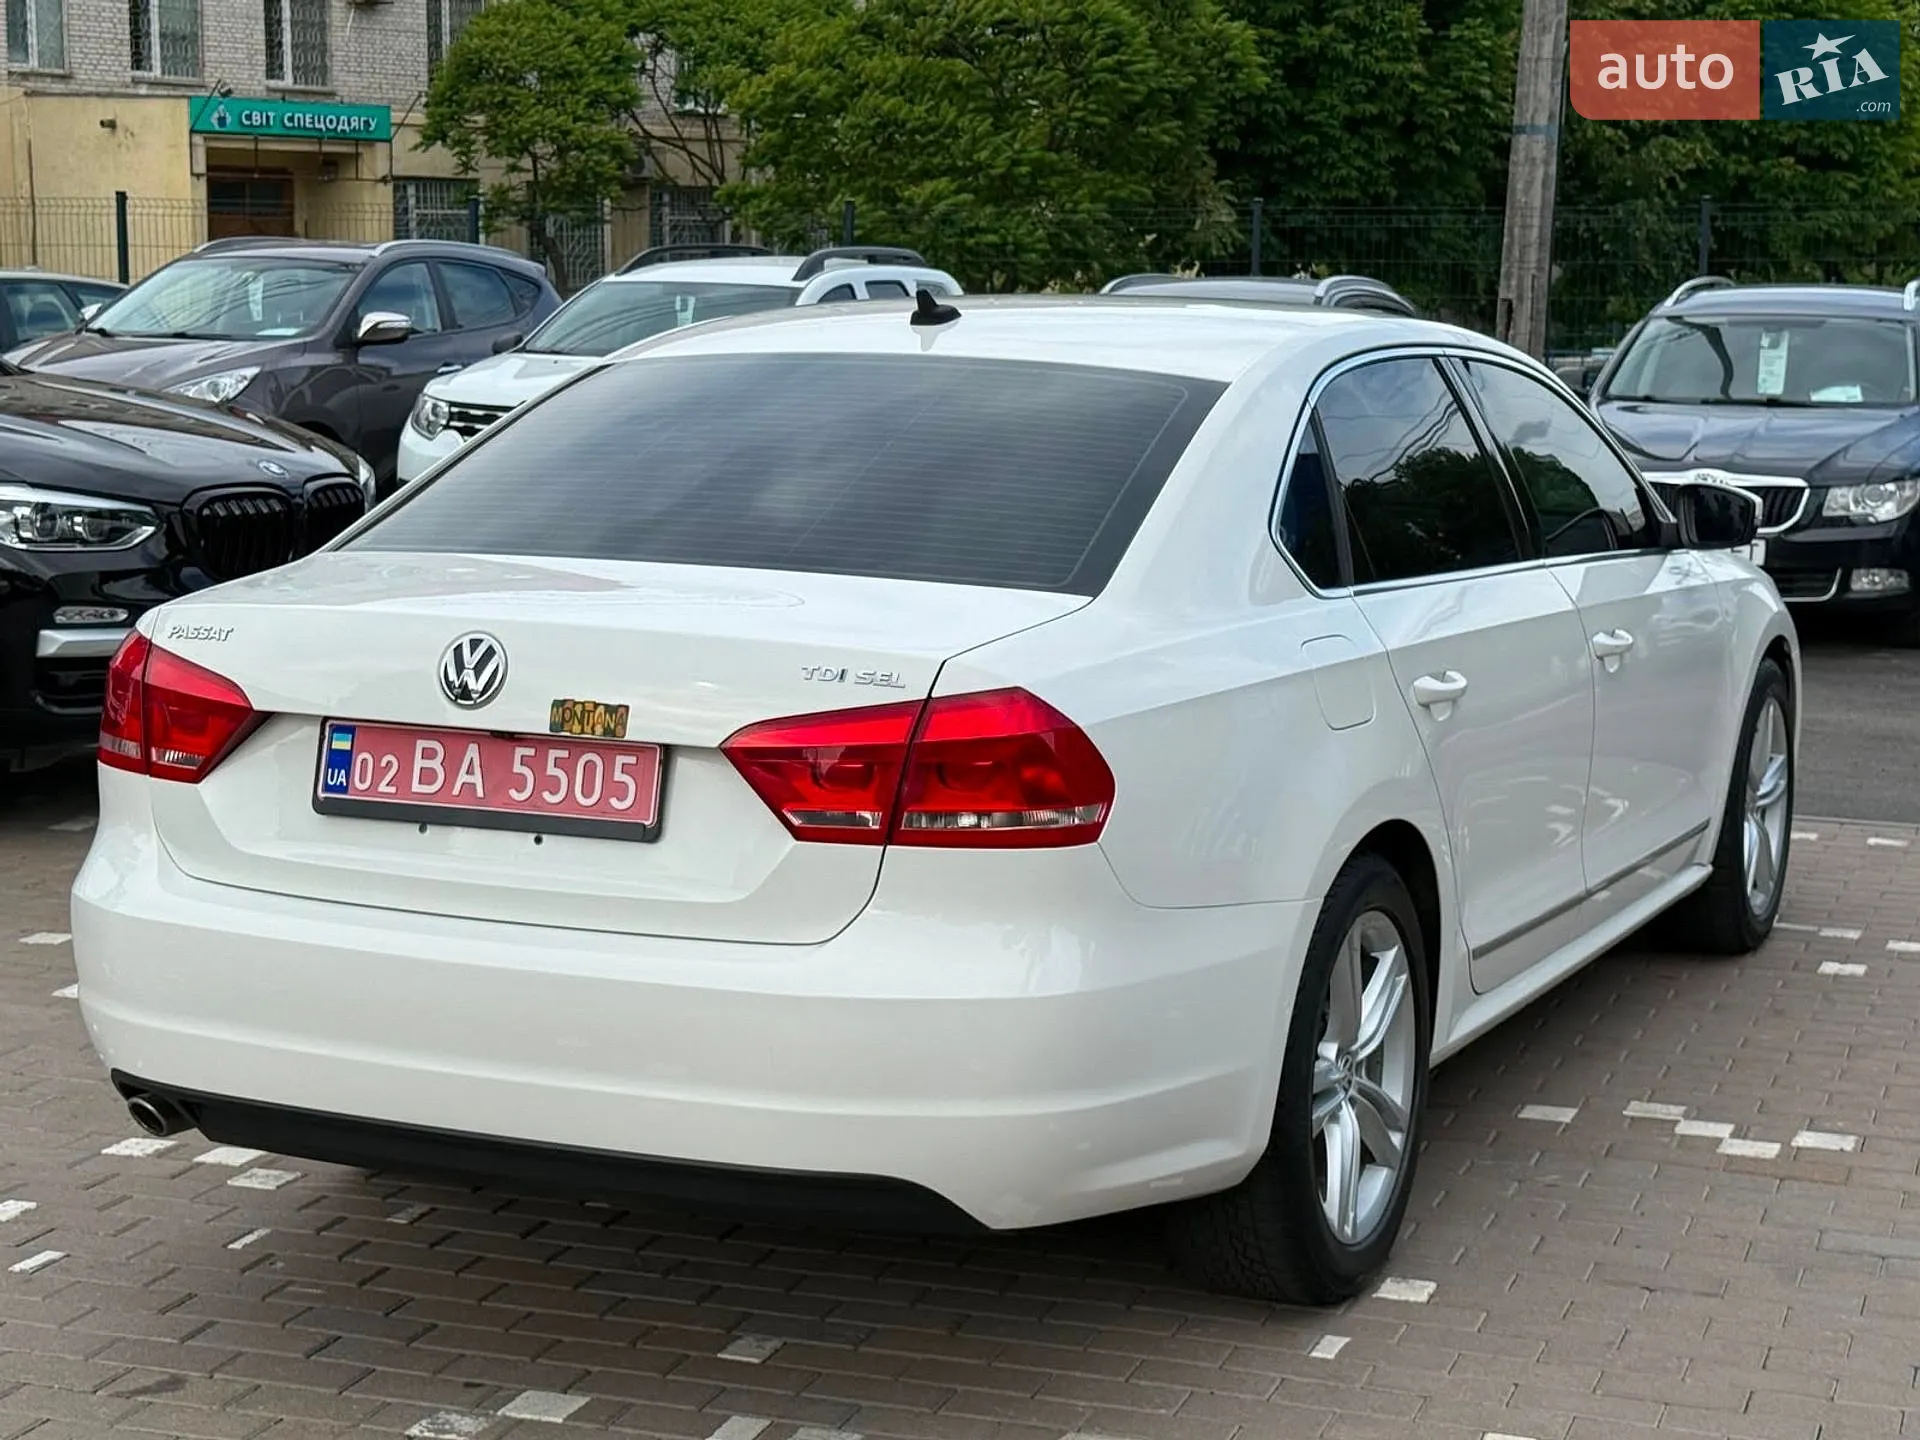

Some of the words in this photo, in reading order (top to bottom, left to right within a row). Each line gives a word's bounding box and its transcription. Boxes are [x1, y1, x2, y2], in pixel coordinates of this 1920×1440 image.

[241, 110, 276, 126] СВІТ
[283, 112, 378, 132] СПЕЦОДЯГУ
[167, 624, 235, 642] PASSAT
[801, 665, 848, 683] TDI
[853, 671, 906, 689] SEL
[327, 768, 348, 788] UA
[354, 752, 399, 794] 02
[411, 739, 485, 798] BA
[508, 746, 639, 811] 5505
